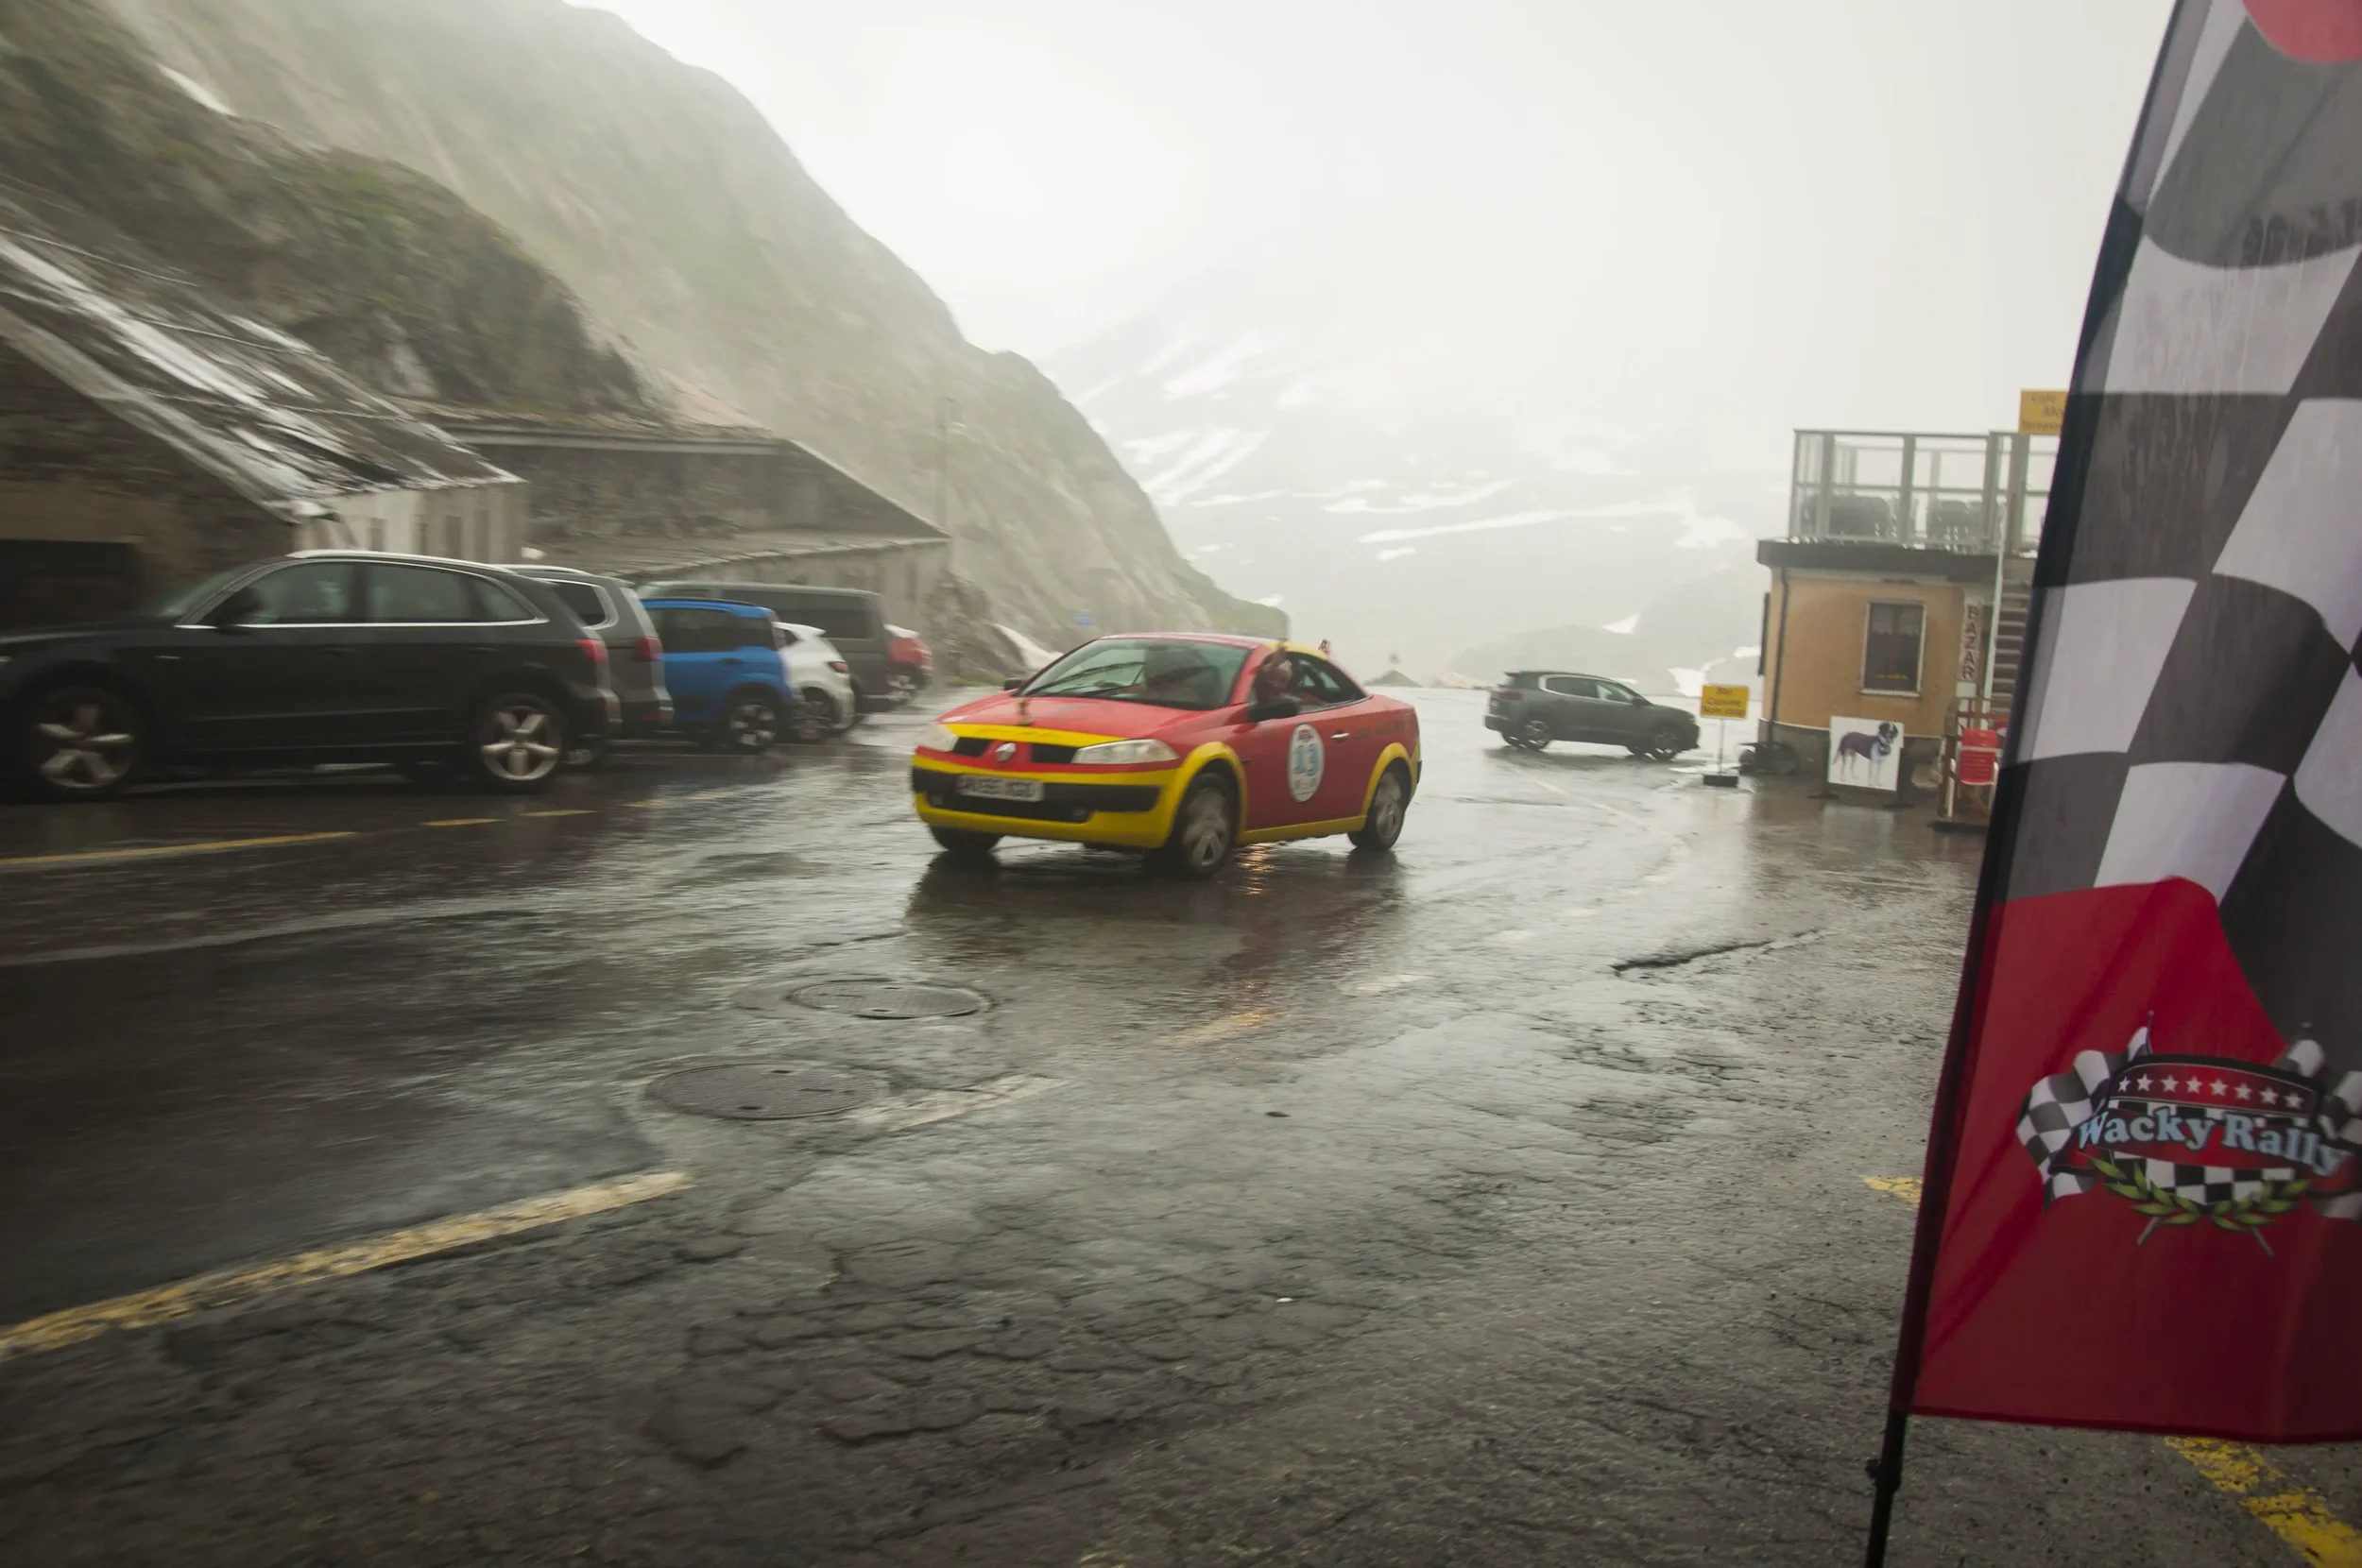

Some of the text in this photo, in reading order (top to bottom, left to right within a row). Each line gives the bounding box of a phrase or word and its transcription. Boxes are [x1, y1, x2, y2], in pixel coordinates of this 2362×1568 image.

[1961, 603, 1978, 679] BAZAR
[1293, 743, 1319, 776] 13
[2079, 1106, 2351, 1177] Wacky Rally
